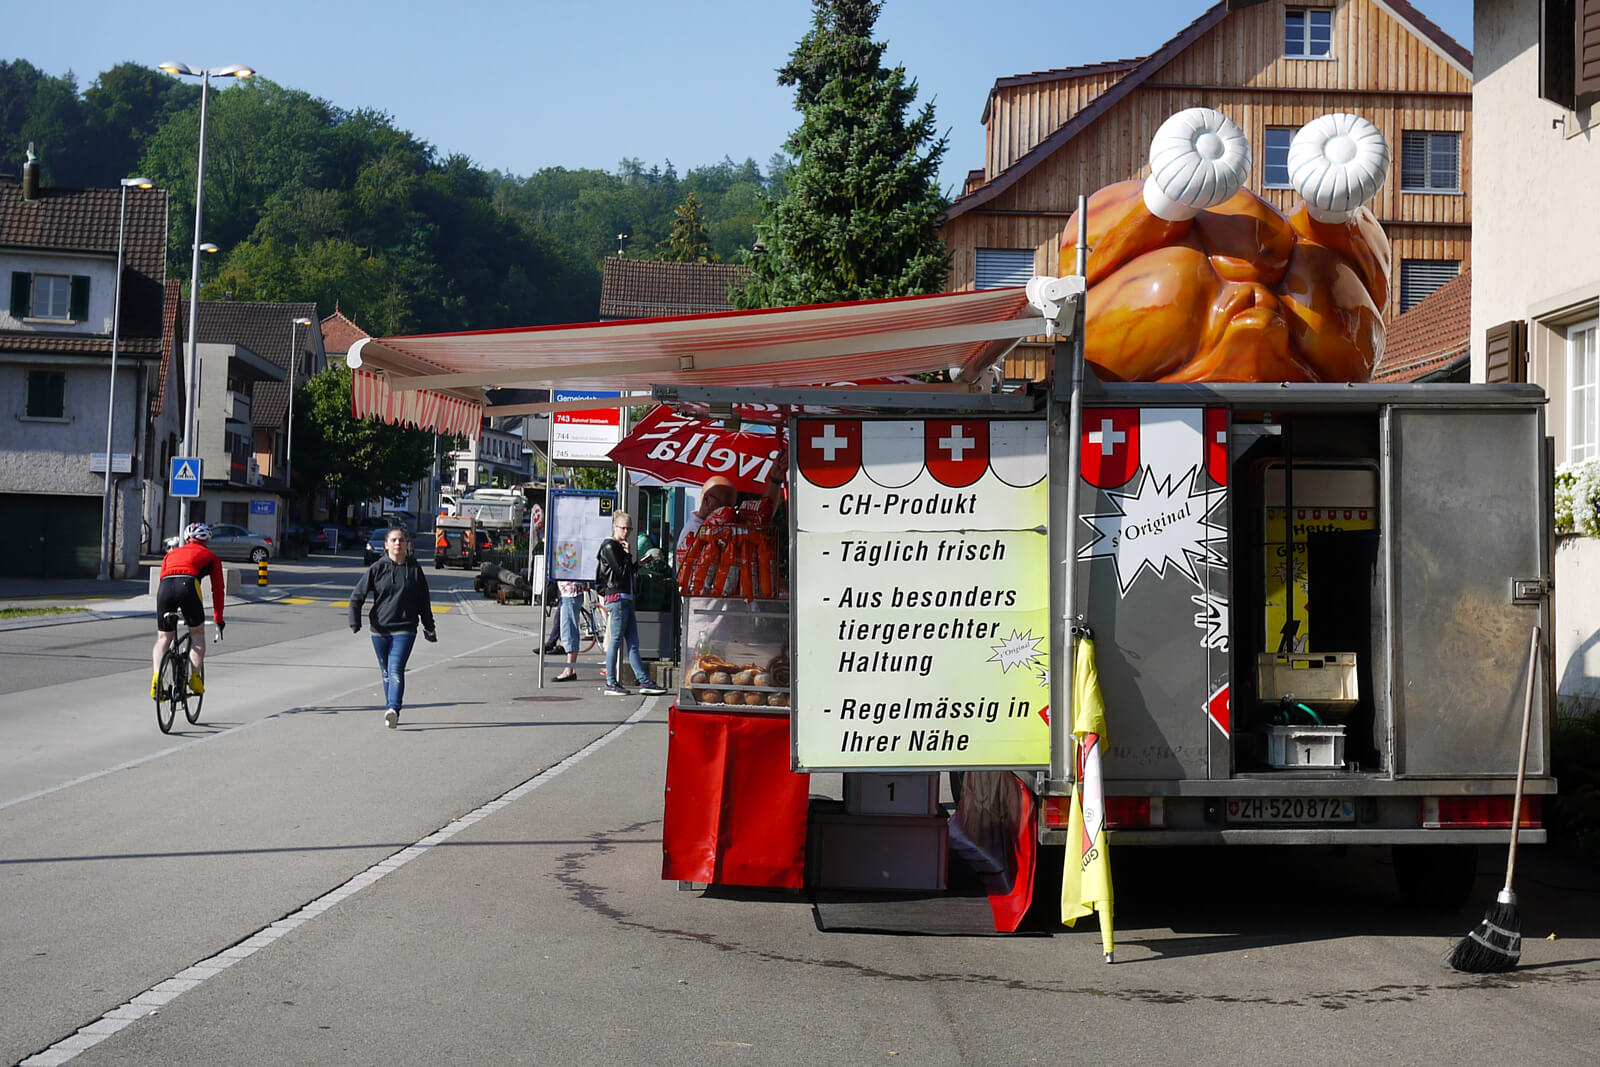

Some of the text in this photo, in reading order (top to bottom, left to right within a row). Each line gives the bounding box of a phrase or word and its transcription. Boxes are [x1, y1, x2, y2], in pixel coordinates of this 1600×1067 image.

[556, 414, 570, 423] 743
[556, 432, 569, 440] 744
[839, 493, 977, 516] CH-Produkt
[1112, 501, 1192, 548] s'Original
[841, 539, 1005, 567] Täglich frisch
[838, 585, 1017, 608] Aus besonders
[838, 618, 1001, 645] tiergerechter
[838, 651, 933, 677] Haltung
[840, 696, 1030, 725] Regelmässig in
[841, 730, 969, 752] Ihrer Nähe
[1304, 747, 1311, 764] 1
[887, 782, 896, 802] 1
